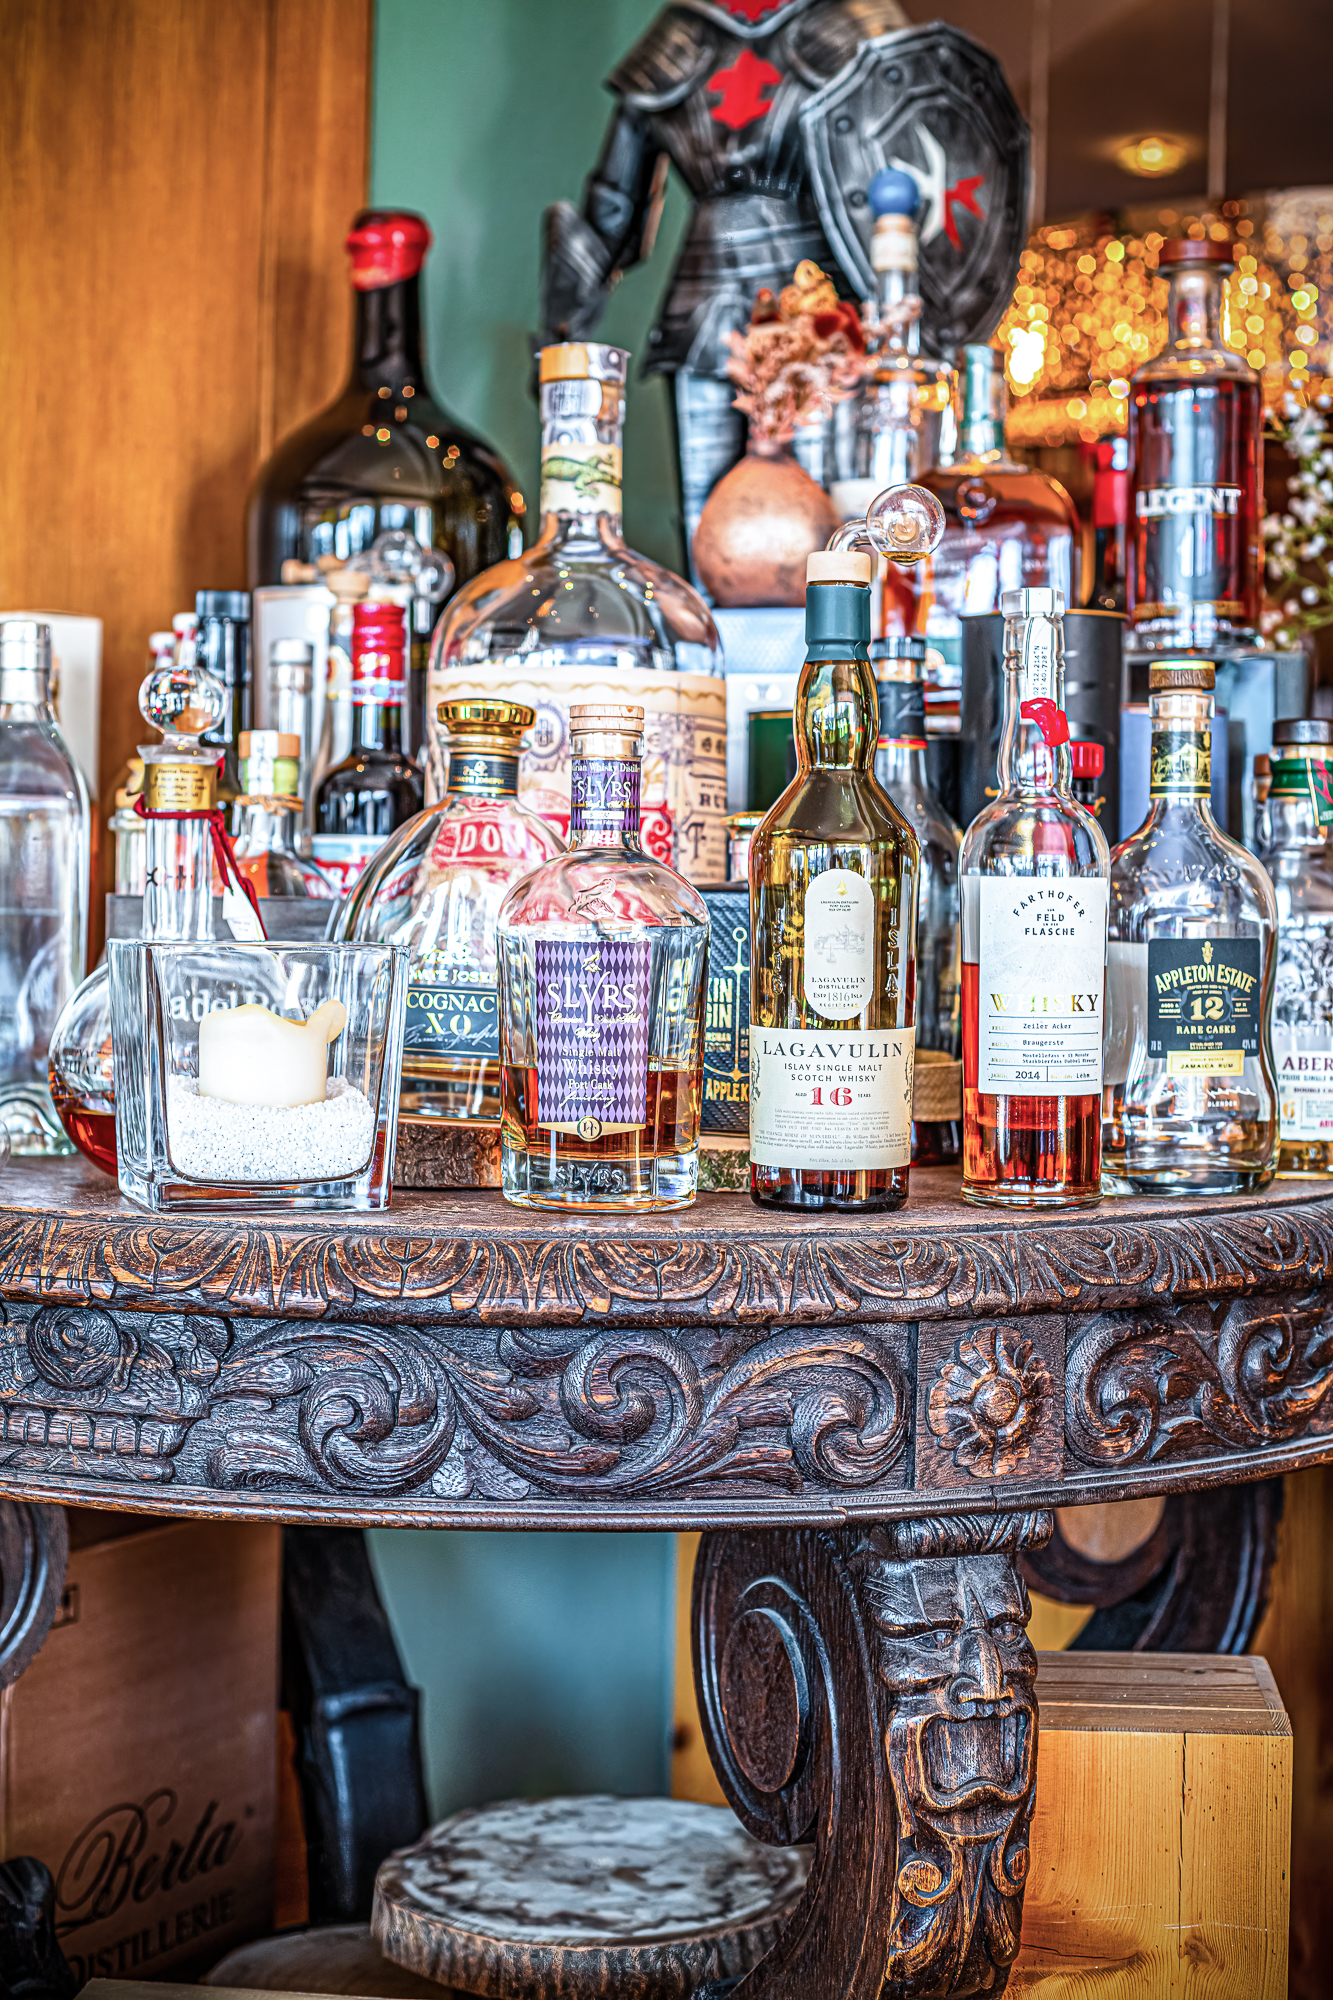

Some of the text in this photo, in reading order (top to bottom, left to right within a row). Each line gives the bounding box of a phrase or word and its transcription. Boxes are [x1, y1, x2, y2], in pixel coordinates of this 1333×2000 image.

[1136, 487, 1242, 517] LEGENT
[589, 762, 617, 774] Whisky
[577, 771, 631, 809] SLYRS
[1012, 889, 1085, 917] FARTHOFER
[1036, 913, 1065, 922] FELD
[1024, 927, 1075, 936] FLASCHE
[1154, 963, 1254, 994] APPLETON ESTATE
[406, 991, 495, 1013] COGNAC
[547, 970, 636, 1027] SLYRS
[828, 992, 850, 1002] 1816
[990, 993, 1099, 1013] WHISKY
[1190, 996, 1225, 1021] 12
[1176, 1024, 1236, 1035] RARE CASKS
[762, 1040, 903, 1059] LAGAVULIN
[1022, 1039, 1065, 1047] Braugerste
[562, 1046, 621, 1060] Single Malt
[562, 1058, 620, 1080] Whisky
[784, 1062, 883, 1072] ISLAY SINGLE MALT
[1281, 1056, 1333, 1071] ABER
[791, 1073, 877, 1082] SCOTCH WHISKY
[1015, 1070, 1041, 1080] 2014
[568, 1078, 613, 1090] Port Cask
[809, 1086, 853, 1107] 16
